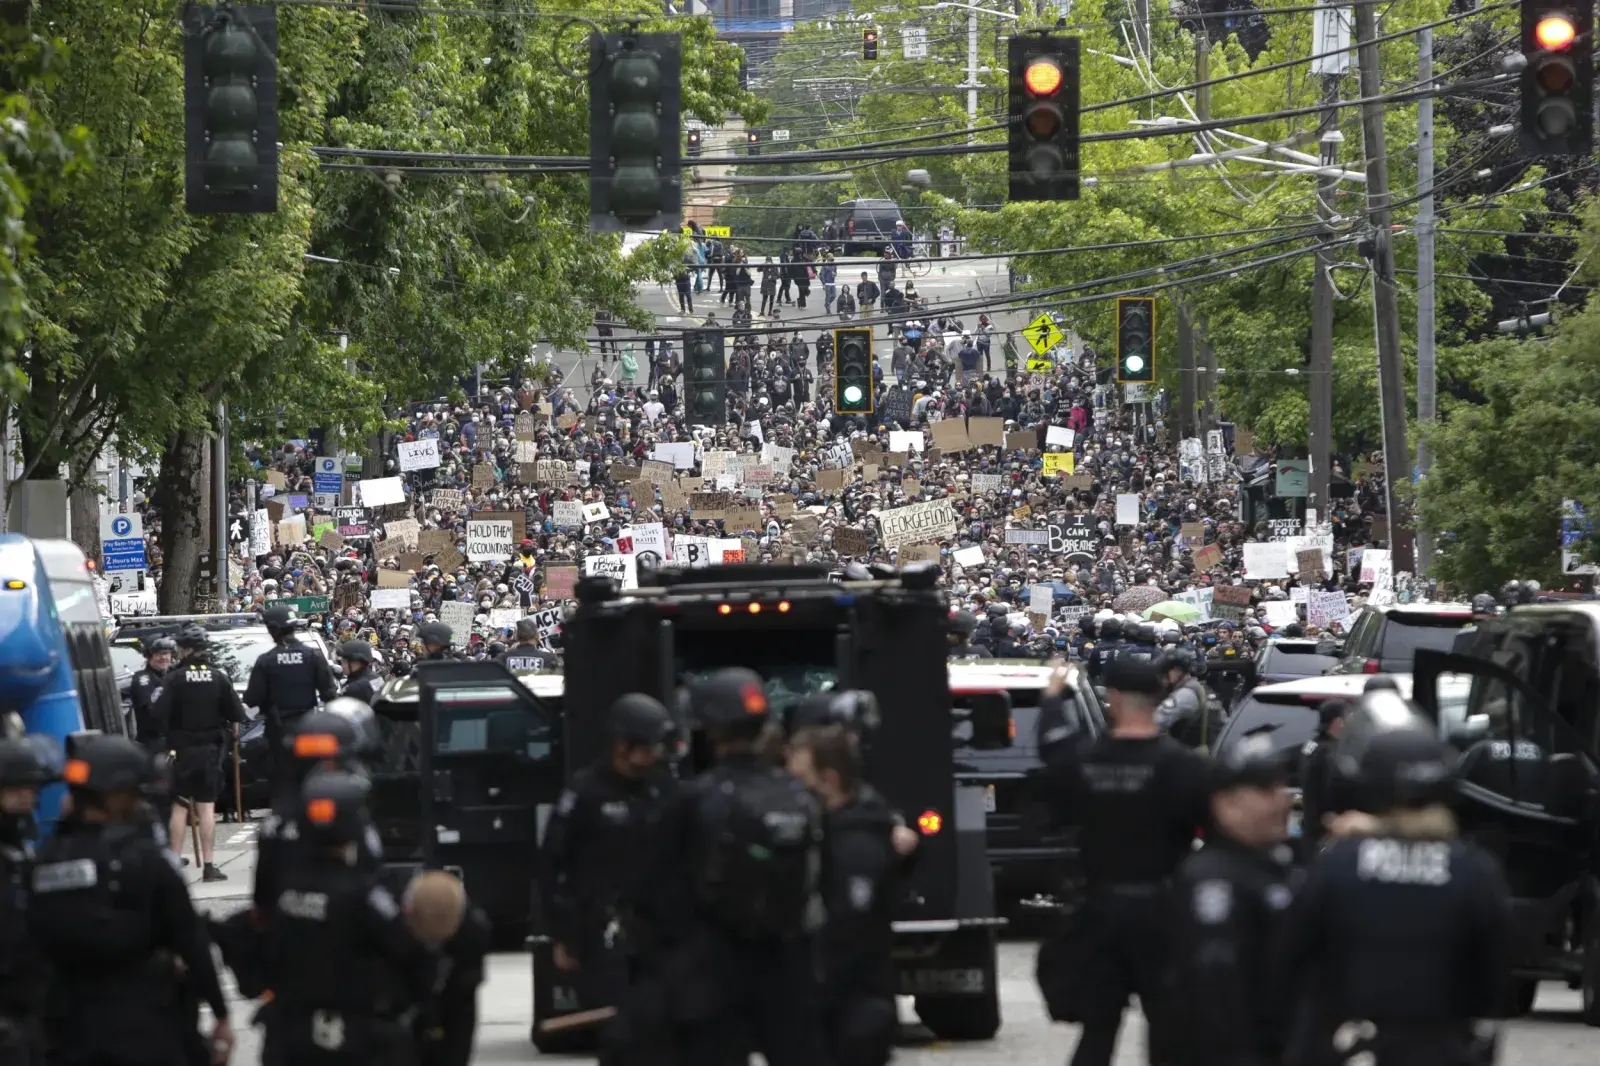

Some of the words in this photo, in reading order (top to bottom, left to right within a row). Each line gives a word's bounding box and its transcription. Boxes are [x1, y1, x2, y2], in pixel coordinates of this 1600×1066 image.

[408, 446, 434, 458] LIVES
[538, 460, 566, 470] BLACK
[538, 470, 566, 480] LIVES
[538, 480, 566, 488] MATTER
[337, 508, 364, 518] ENOUGH
[886, 510, 902, 519] SAY
[1073, 515, 1084, 525] I
[1268, 518, 1302, 528] JUSTICE
[469, 524, 492, 538] HOLD
[492, 524, 512, 538] THEM
[1066, 528, 1090, 538] CAN'T
[1274, 528, 1295, 536] FOR
[468, 542, 513, 556] ACCOUNTABLE
[1062, 538, 1096, 553] BREATHE
[1325, 607, 1346, 618] NOW
[536, 610, 560, 629] ACK
[278, 652, 304, 666] POLICE
[510, 659, 541, 670] POLICE
[186, 670, 214, 684] POLICE
[1490, 742, 1540, 761] POICE
[1358, 840, 1450, 884] POLICE
